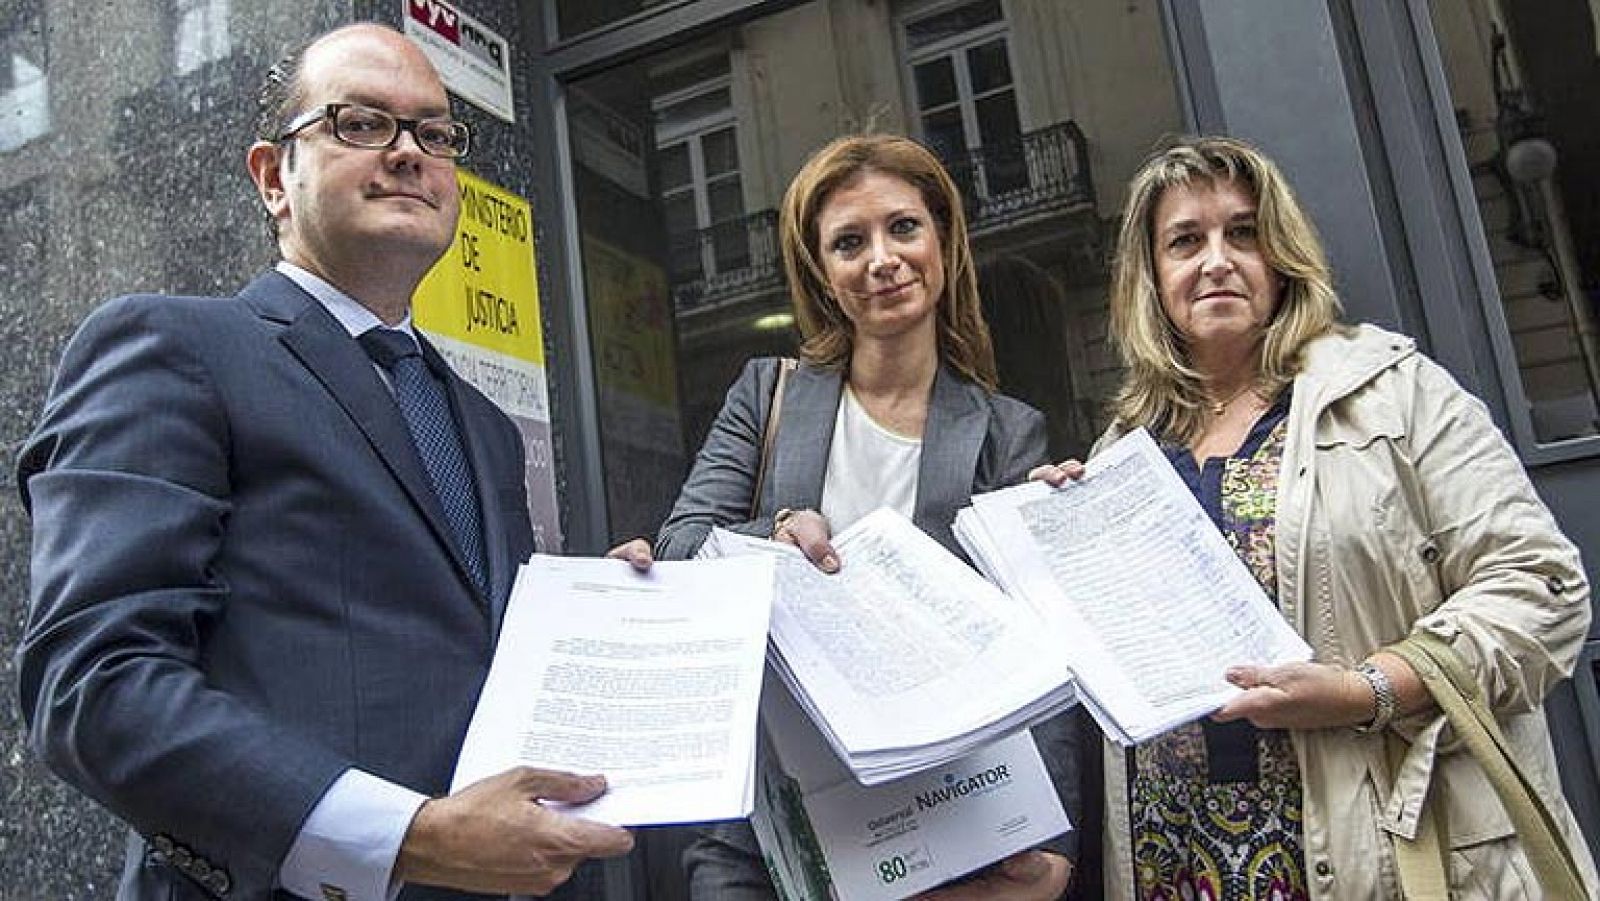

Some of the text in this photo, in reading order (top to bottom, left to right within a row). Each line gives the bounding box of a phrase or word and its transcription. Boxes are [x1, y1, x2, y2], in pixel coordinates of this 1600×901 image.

[462, 232, 480, 271] DE
[466, 287, 520, 334] JUSTICIA
[915, 764, 1009, 811] NAVIGATOR
[878, 856, 907, 883] 80
